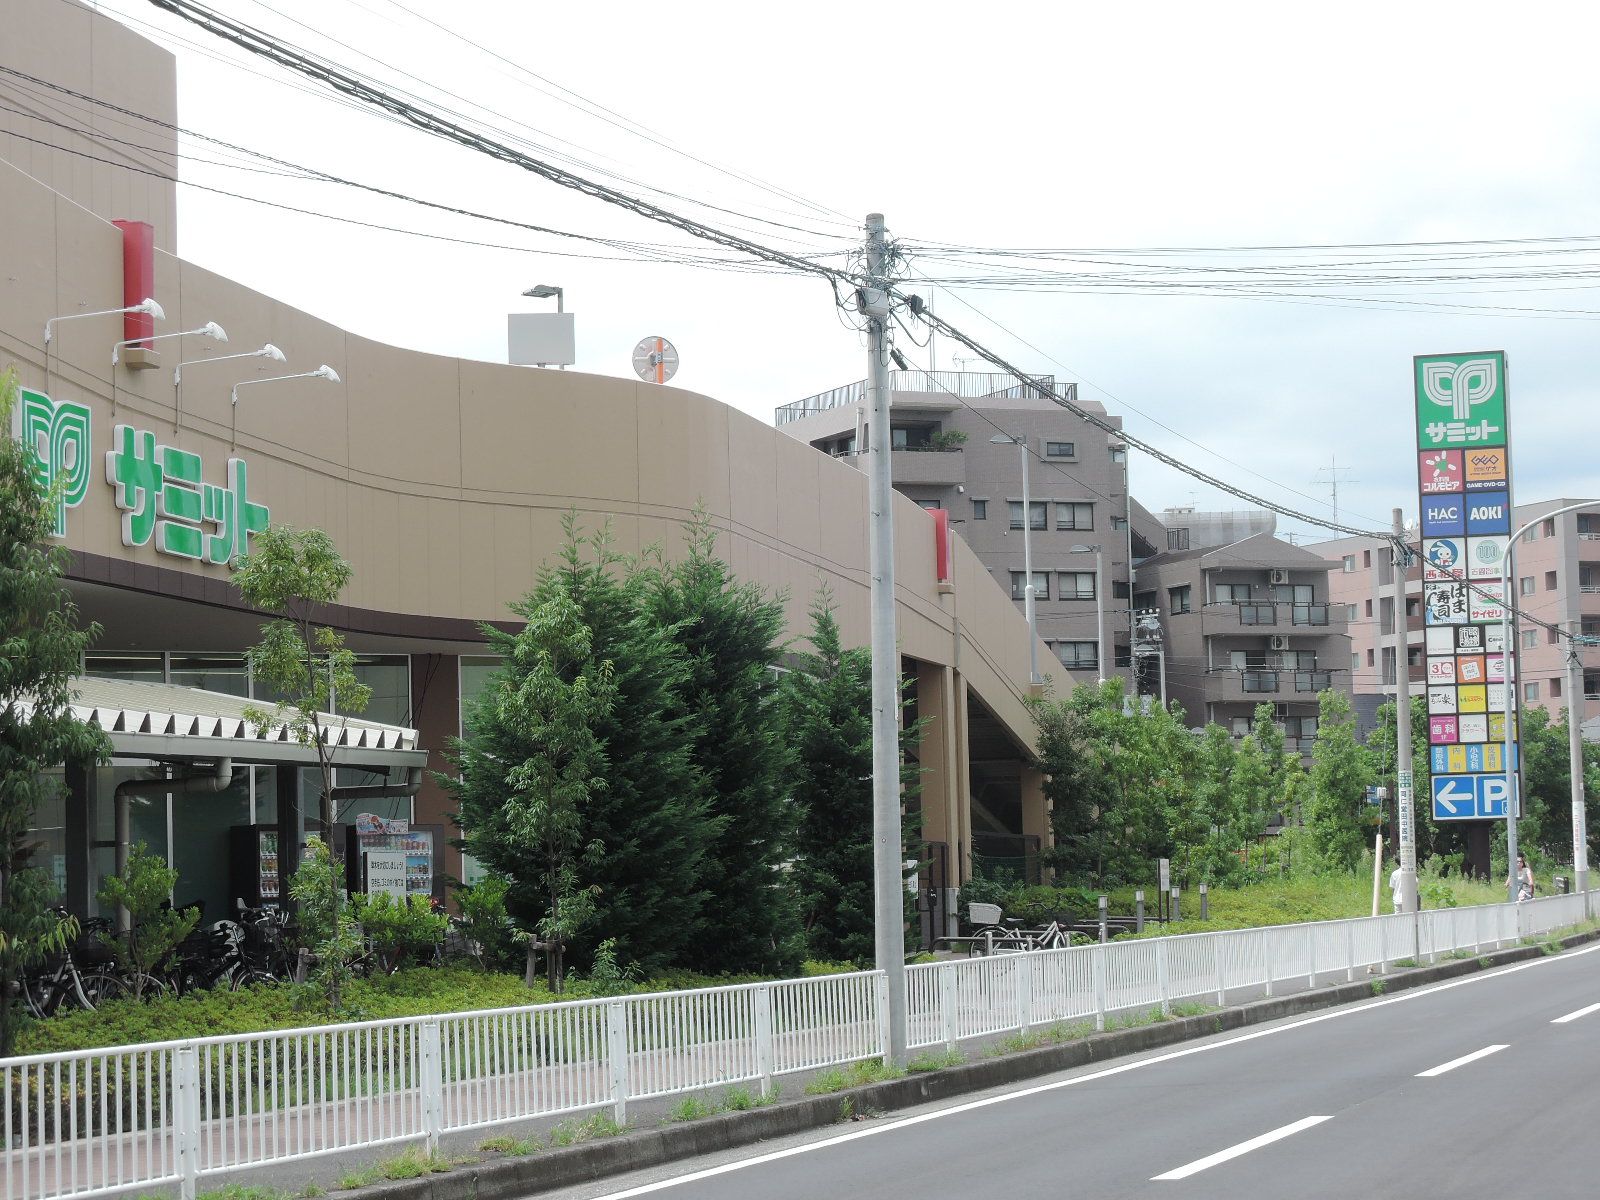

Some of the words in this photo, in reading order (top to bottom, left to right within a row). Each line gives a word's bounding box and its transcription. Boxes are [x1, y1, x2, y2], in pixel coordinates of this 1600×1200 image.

[1425, 420, 1500, 443] サミット
[1471, 454, 1500, 466] GEO
[1423, 481, 1460, 492] コルモピア
[105, 424, 270, 571] サミット
[1428, 506, 1458, 520] HAC
[1469, 505, 1502, 521] AOKI
[1479, 545, 1498, 559] 100
[1436, 590, 1451, 618] 寿司
[1450, 582, 1466, 614] はま
[1471, 609, 1503, 619] サイゼリ
[1432, 723, 1456, 735] 歯科
[1452, 747, 1461, 770] 内科
[1469, 745, 1479, 770] 小児科
[1484, 779, 1507, 813] P
